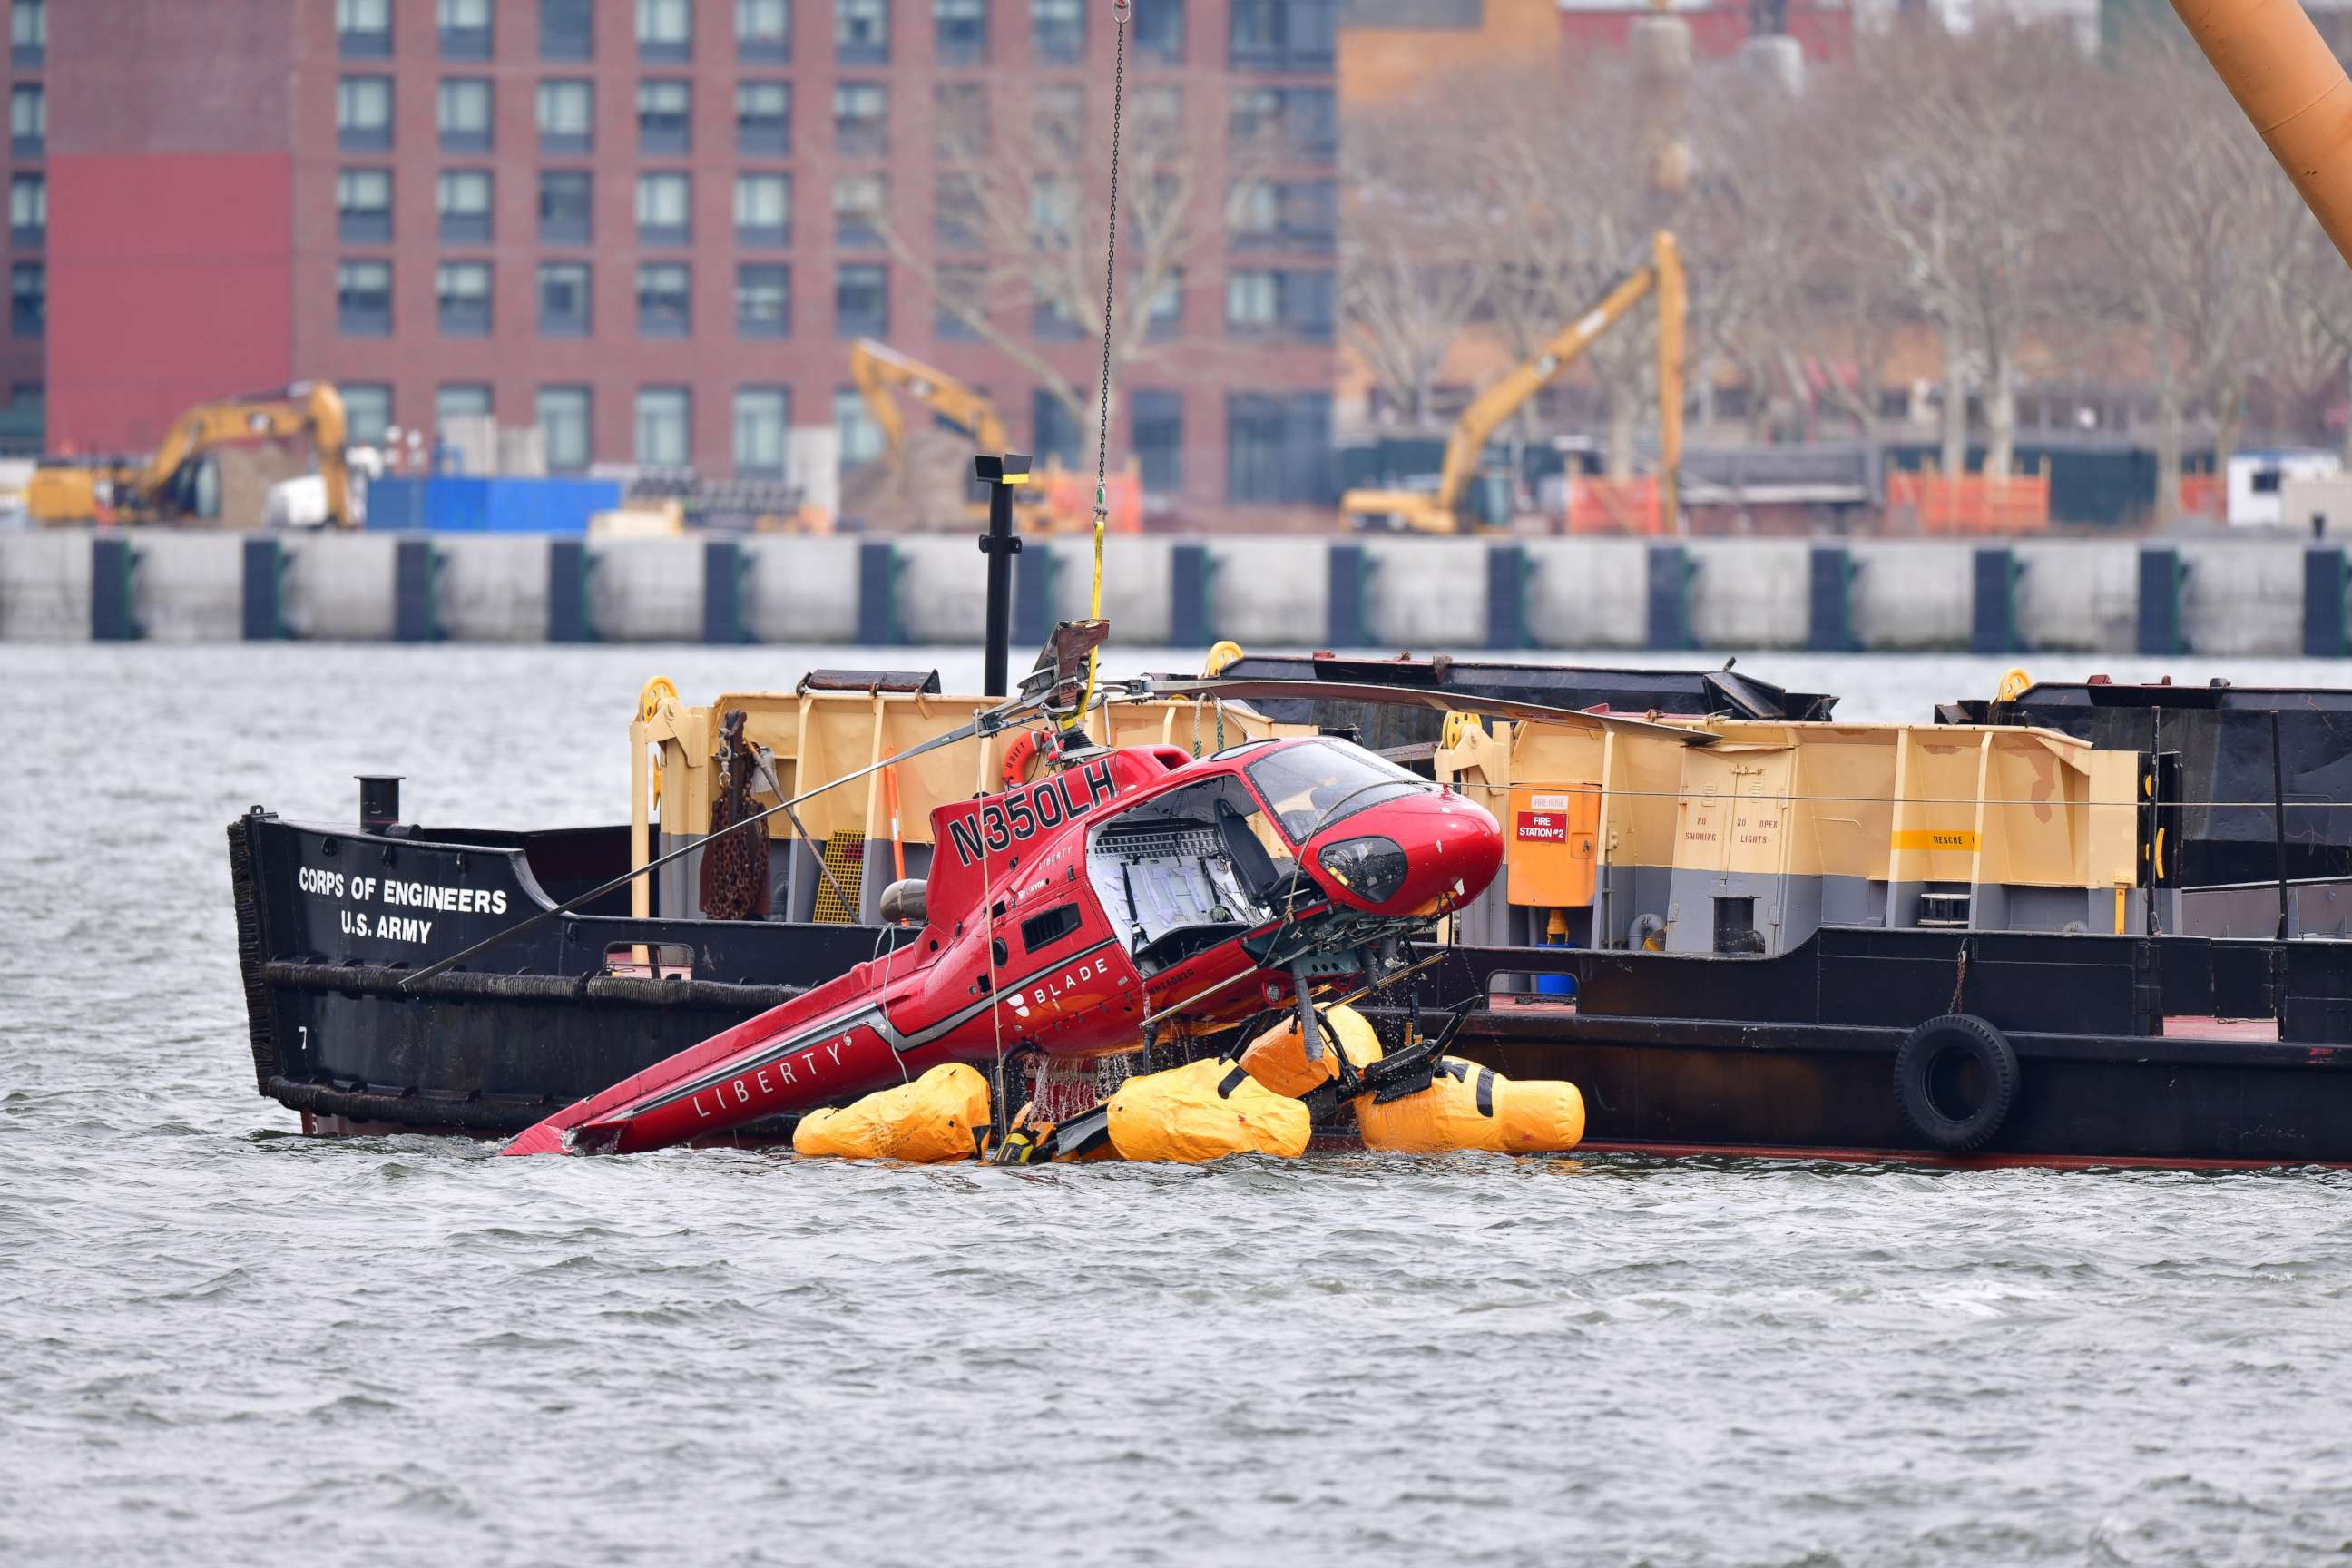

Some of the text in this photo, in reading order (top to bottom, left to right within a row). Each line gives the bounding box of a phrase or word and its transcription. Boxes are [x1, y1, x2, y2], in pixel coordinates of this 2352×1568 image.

[947, 760, 1118, 867] N350LH
[1534, 817, 1551, 826] FIRE
[1697, 817, 1707, 826] NO
[1737, 818, 1779, 829] NO OPEN
[1519, 827, 1564, 838] STATION #2
[1684, 832, 1717, 842] SMOKING
[1740, 835, 1768, 845] LIGHTS
[1933, 836, 1963, 844] RESCUE
[1038, 846, 1073, 870] LIBERTY
[299, 866, 508, 915] CORPS OF ENGINEERS
[341, 909, 433, 945] U.S. ARMY
[1034, 957, 1108, 1004] BLADE
[299, 1025, 307, 1050] 7
[692, 1042, 841, 1118] LIBERTY
